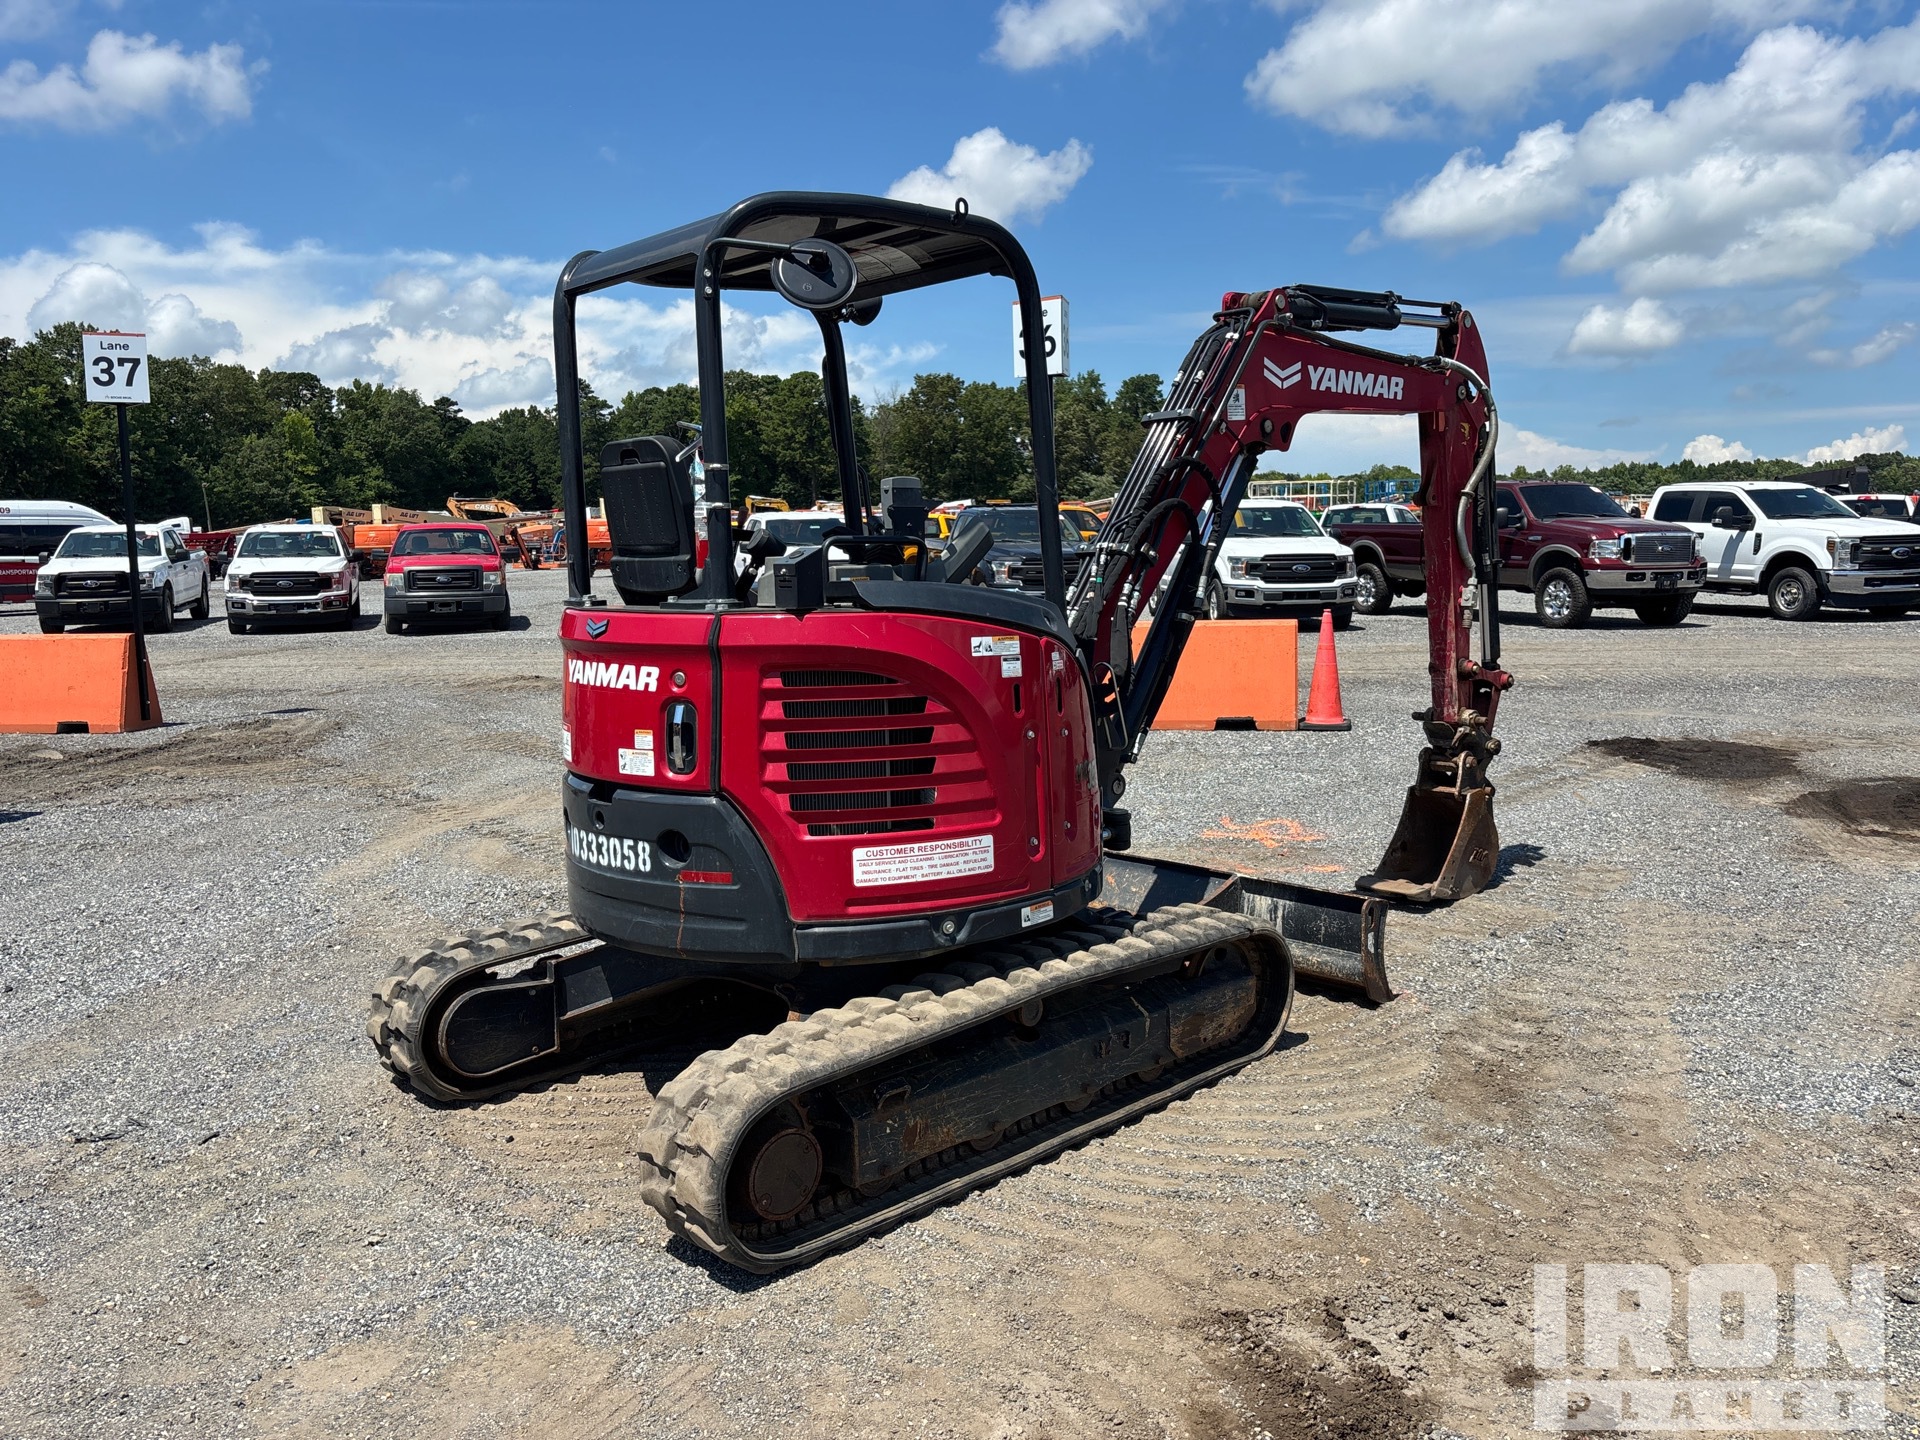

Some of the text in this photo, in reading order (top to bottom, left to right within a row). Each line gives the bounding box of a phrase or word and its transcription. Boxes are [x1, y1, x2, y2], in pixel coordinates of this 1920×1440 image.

[100, 341, 130, 350] Lane
[92, 356, 141, 387] 37
[1307, 365, 1404, 400] YANMAR
[568, 658, 660, 692] YANMAR
[865, 838, 984, 858] CUSTOMER RESPONSIBILITY
[861, 868, 892, 876] INSURANCE
[939, 860, 960, 868] DAMAGE
[963, 856, 988, 865] REFUELING
[874, 859, 897, 867] SERVICE
[909, 855, 935, 863] CLEANING
[938, 851, 970, 860] LUBRICATION
[887, 873, 918, 881] EQUIPMENT
[921, 871, 943, 879] BATTERY
